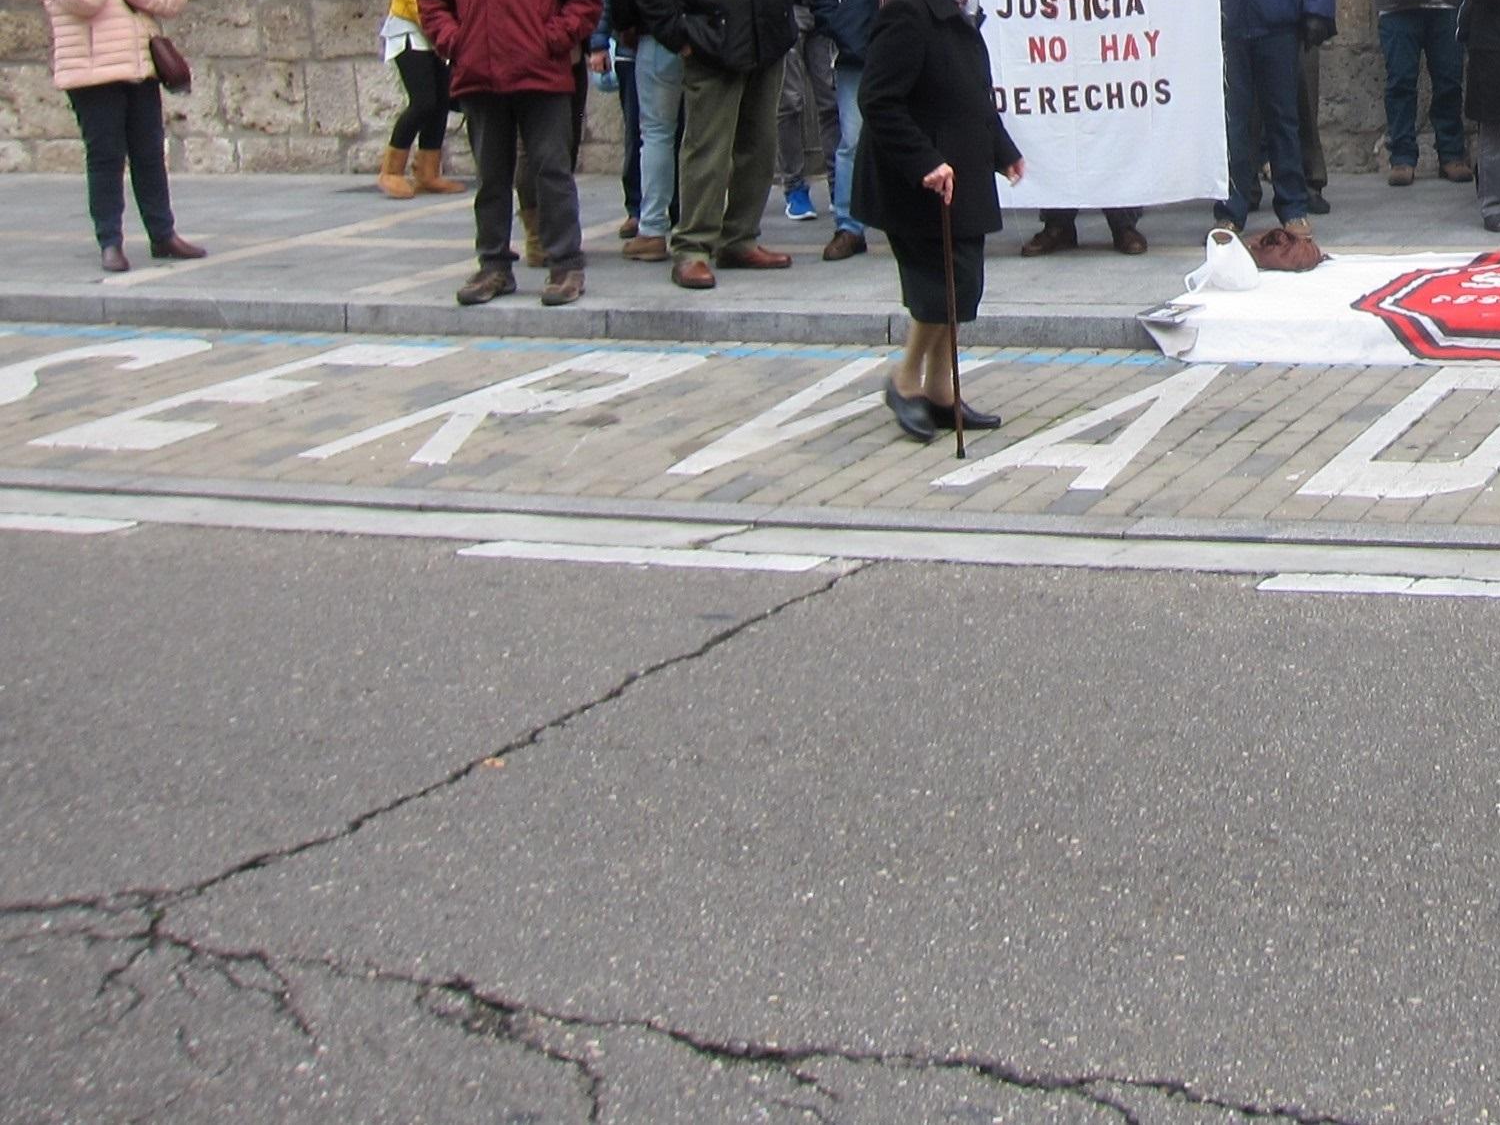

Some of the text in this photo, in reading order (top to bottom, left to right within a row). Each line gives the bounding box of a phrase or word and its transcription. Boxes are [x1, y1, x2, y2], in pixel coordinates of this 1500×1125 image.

[1028, 30, 1160, 63] NO HAY
[992, 79, 1171, 115] DERECHOS
